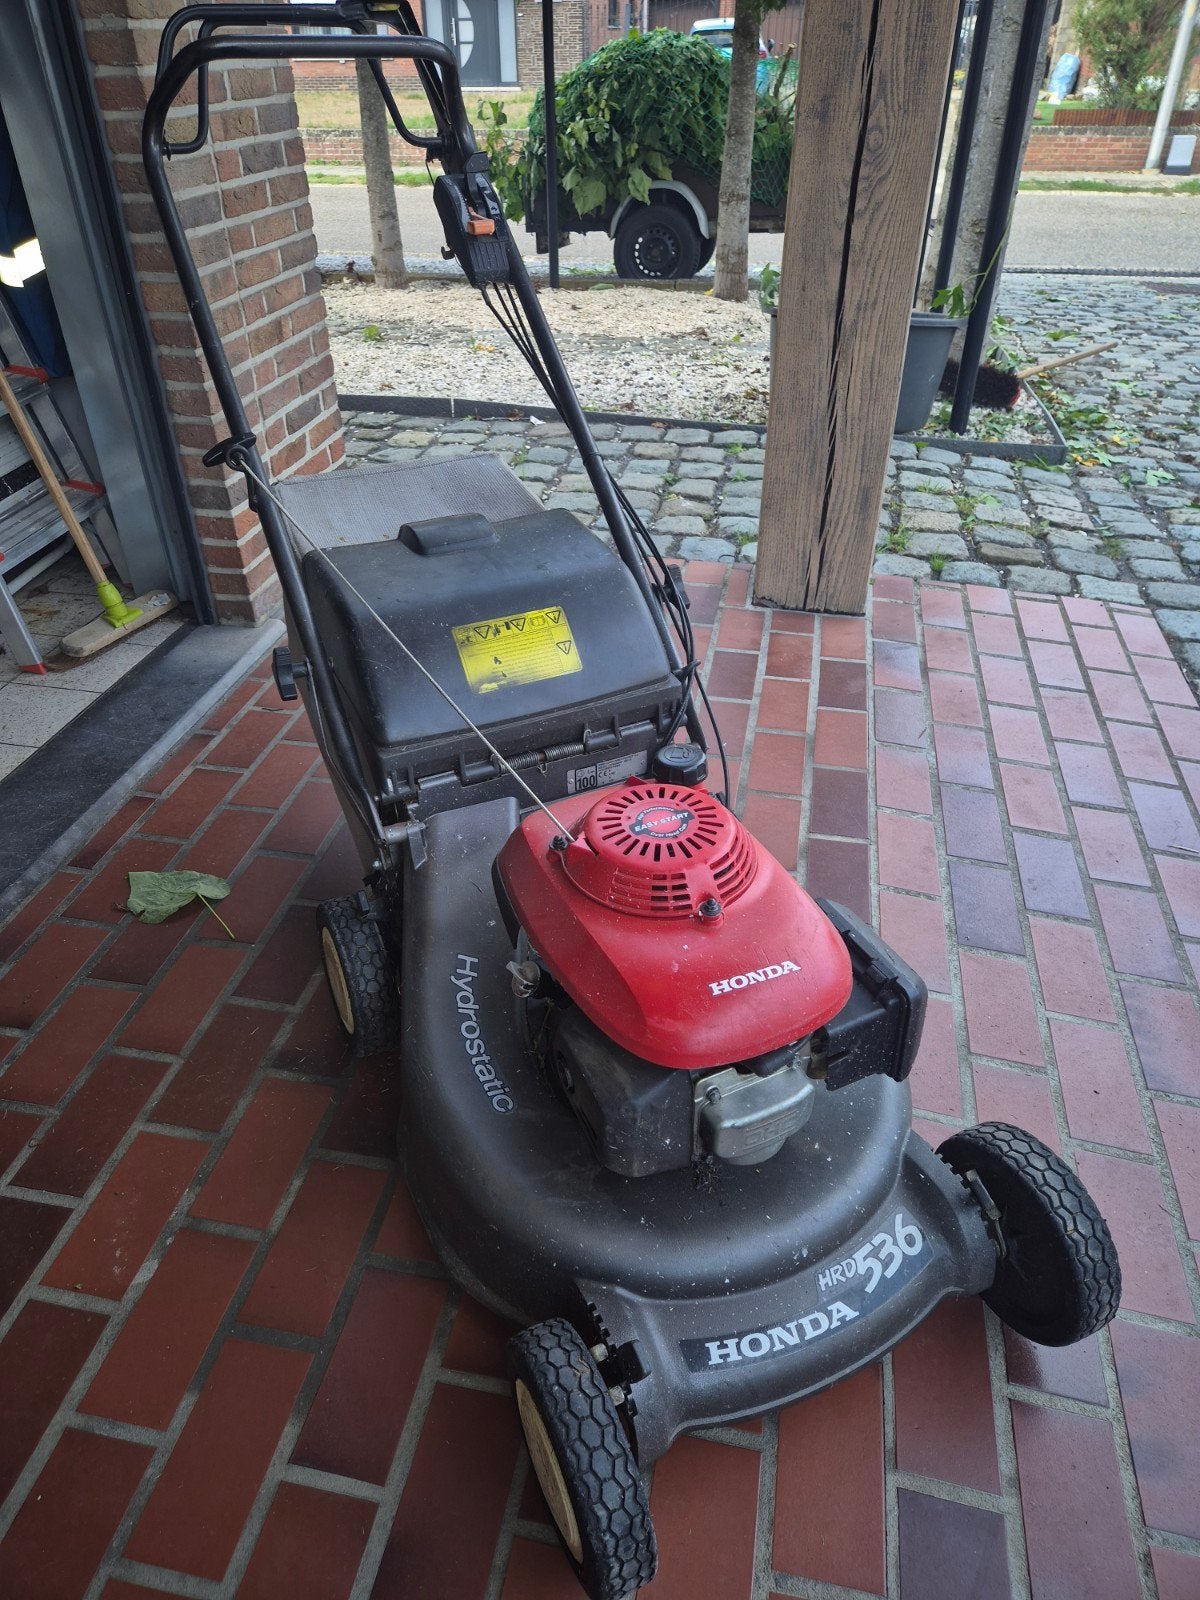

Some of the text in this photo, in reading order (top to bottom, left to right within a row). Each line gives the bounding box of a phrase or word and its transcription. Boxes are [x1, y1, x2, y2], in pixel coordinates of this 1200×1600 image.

[577, 775, 596, 790] 100
[634, 811, 689, 832] EASY START
[665, 830, 680, 838] Head
[708, 960, 802, 996] HONDA
[450, 953, 514, 1113] Hydrostatic
[705, 1301, 860, 1366] HONDA
